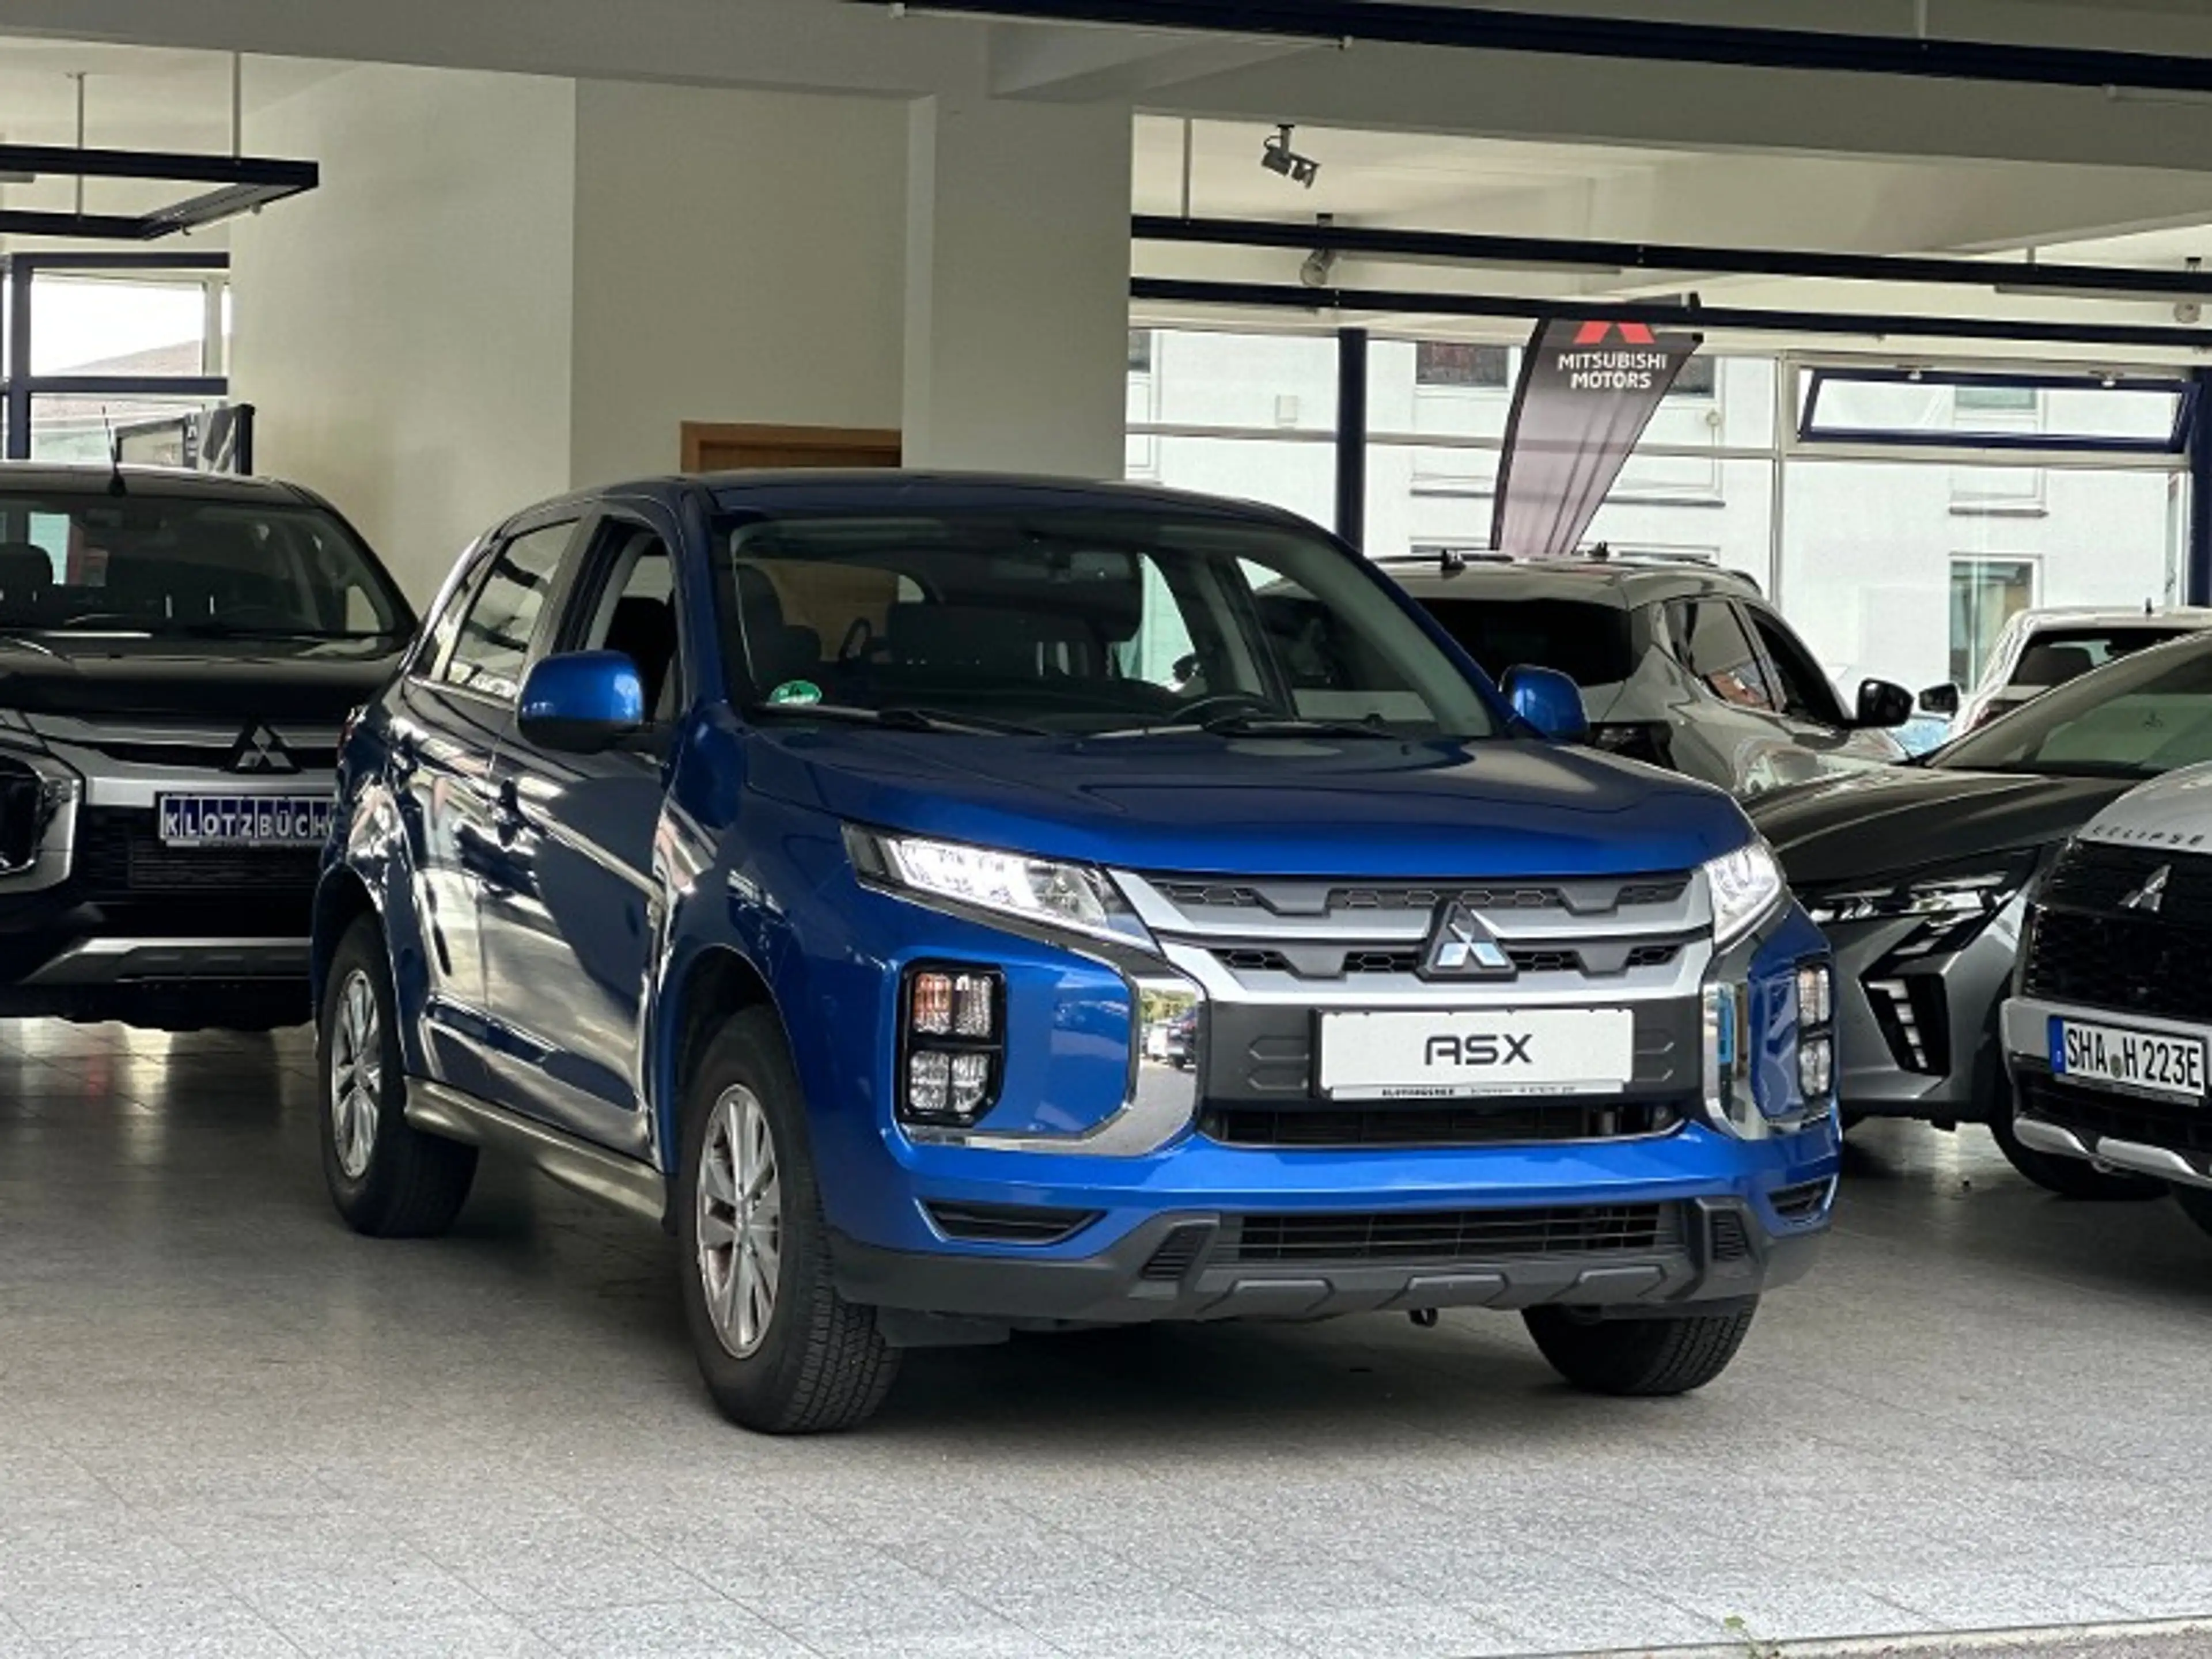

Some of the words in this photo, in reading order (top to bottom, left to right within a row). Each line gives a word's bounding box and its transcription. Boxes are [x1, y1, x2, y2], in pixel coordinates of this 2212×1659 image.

[1558, 352, 1668, 370] MITSUBISHI
[1570, 373, 1652, 389] MOTORS
[165, 810, 329, 836] KLOTZBÜCH
[1424, 1034, 1533, 1066] ASX
[2067, 1028, 2107, 1073] SHA
